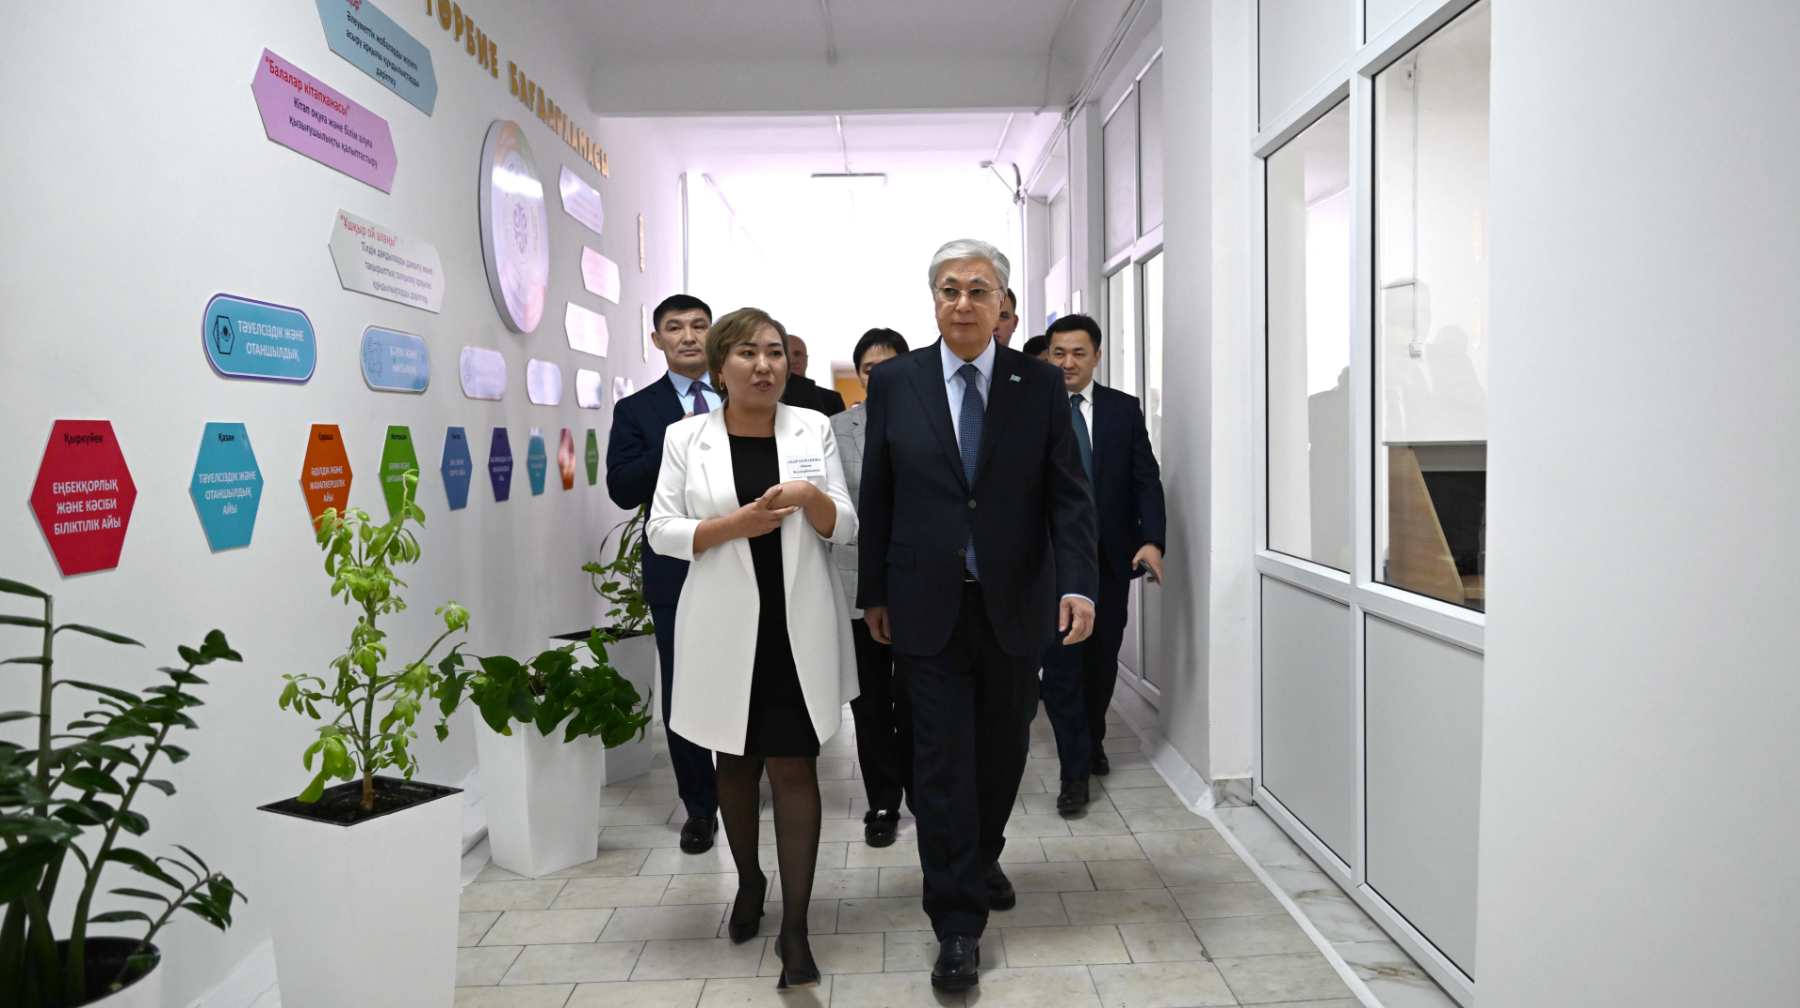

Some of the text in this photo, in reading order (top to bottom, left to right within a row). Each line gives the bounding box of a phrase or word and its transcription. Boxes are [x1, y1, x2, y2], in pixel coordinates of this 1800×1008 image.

[293, 96, 373, 149] Кітап оқуға және білім алуға
[508, 60, 609, 178] БАҒДАРЛАМАСЫ
[341, 142, 378, 169] қалыптастыру
[367, 226, 376, 240] ой
[237, 320, 304, 342] ТӘУЕЛСІЗДІК ЖӘНЕ
[246, 342, 300, 363] ОТАНШЫЛДЫҚ
[64, 432, 104, 446] Қыркүйек
[218, 433, 235, 443] Қазан
[198, 470, 257, 484] ТӘУЕЛСІЗДІК ЖӘНЕ
[52, 478, 119, 496] ЕҢБЕКҚОРЛЫҚ
[205, 487, 252, 500] ОТАНШЫЛДЫҚ
[56, 498, 117, 514] ЖӘНЕ КӘСІБИ
[223, 502, 238, 515] АЙЫ
[54, 515, 122, 535] БІЛІКТІЛІК АЙЫ
